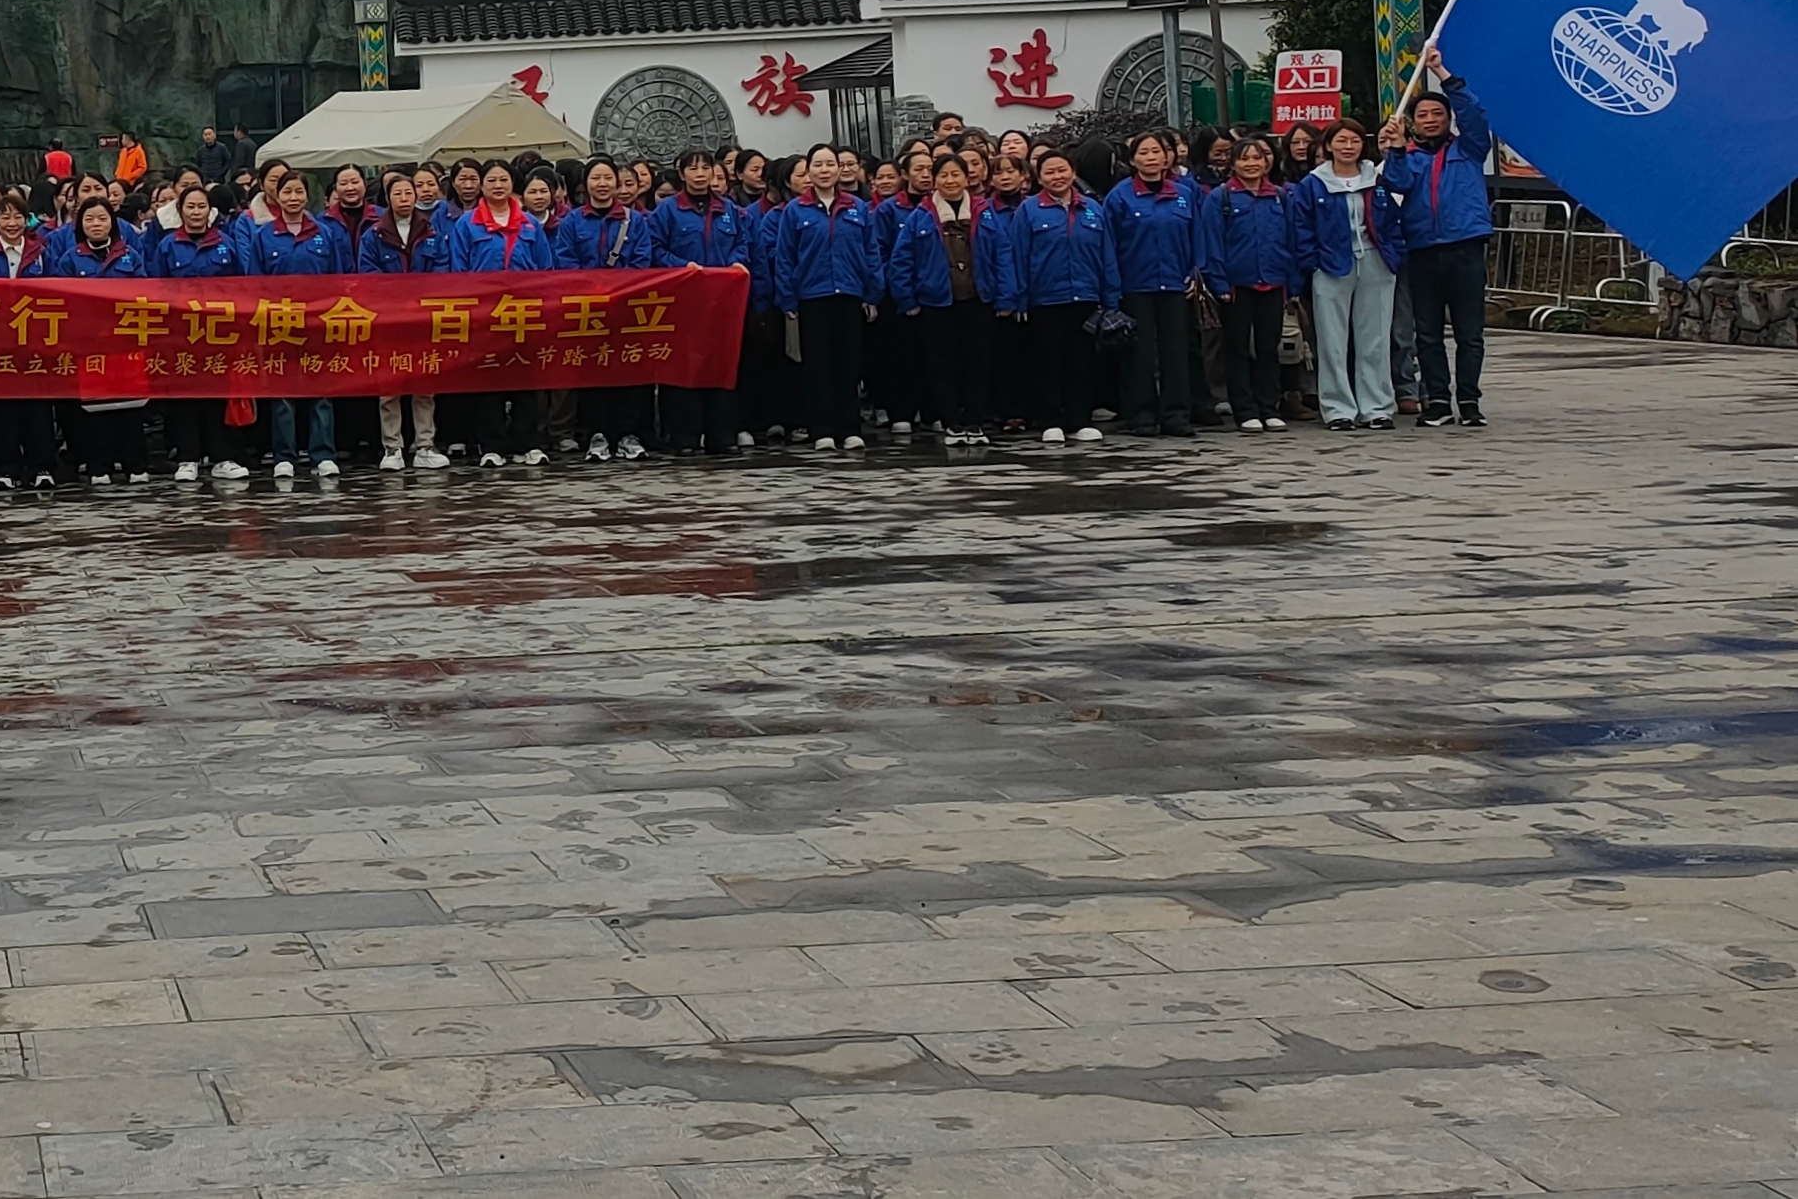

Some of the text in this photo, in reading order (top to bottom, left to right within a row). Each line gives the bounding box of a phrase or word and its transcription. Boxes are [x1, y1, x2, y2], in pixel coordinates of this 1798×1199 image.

[741, 51, 815, 116] 族
[987, 28, 1075, 109] 进
[1285, 68, 1330, 89] 入口
[1290, 53, 1324, 66] 观众
[1562, 20, 1664, 103] SHARPNESS
[1276, 105, 1335, 122] 禁止推拉
[113, 296, 378, 347] 牢记使命
[420, 290, 677, 344] 百年玉立
